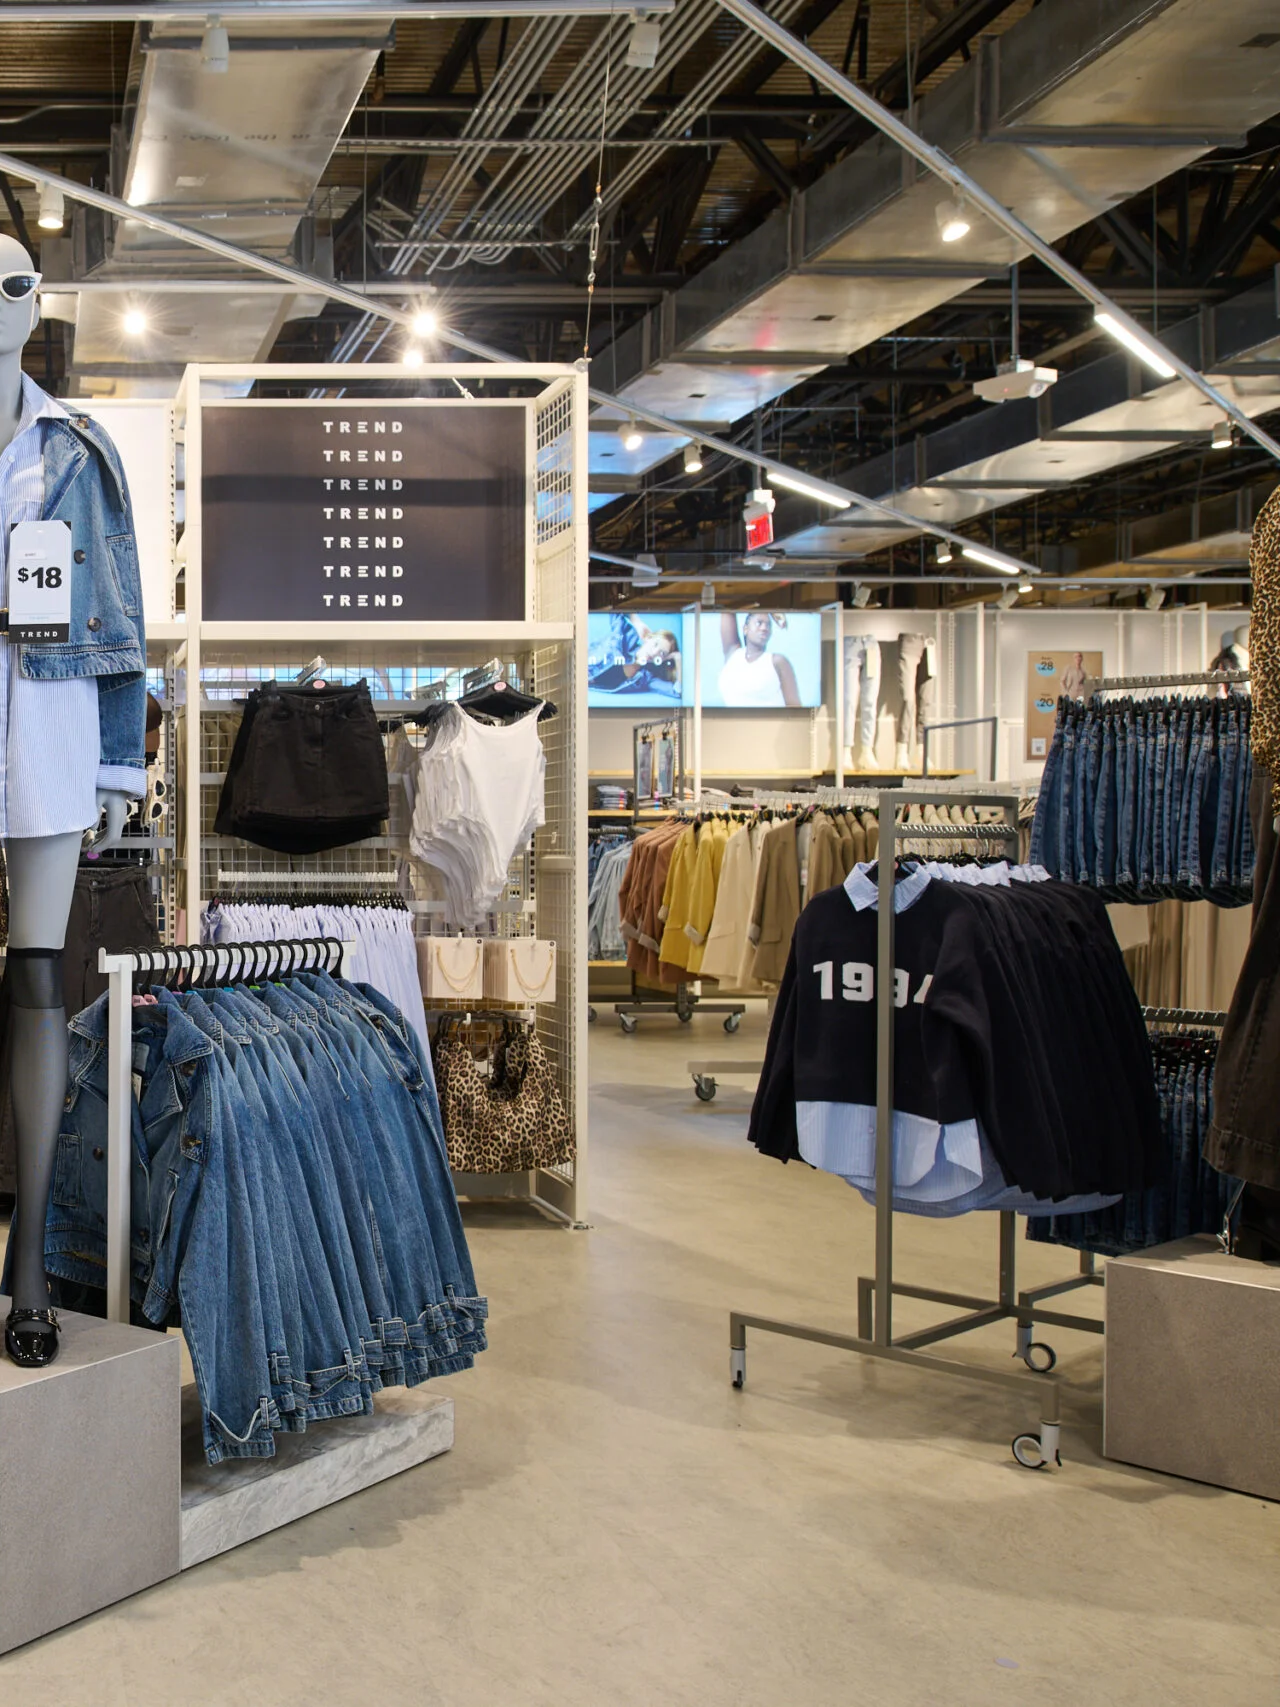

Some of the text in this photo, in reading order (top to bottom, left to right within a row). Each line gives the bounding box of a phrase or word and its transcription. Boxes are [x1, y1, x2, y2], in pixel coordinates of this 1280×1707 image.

[323, 421, 403, 433] TREND
[323, 450, 403, 462] TREND
[323, 479, 403, 491] TREND
[323, 508, 403, 520] TREND
[323, 537, 403, 549] TREND
[17, 566, 62, 589] $18
[323, 566, 403, 578] TREND
[323, 595, 403, 607] TREND
